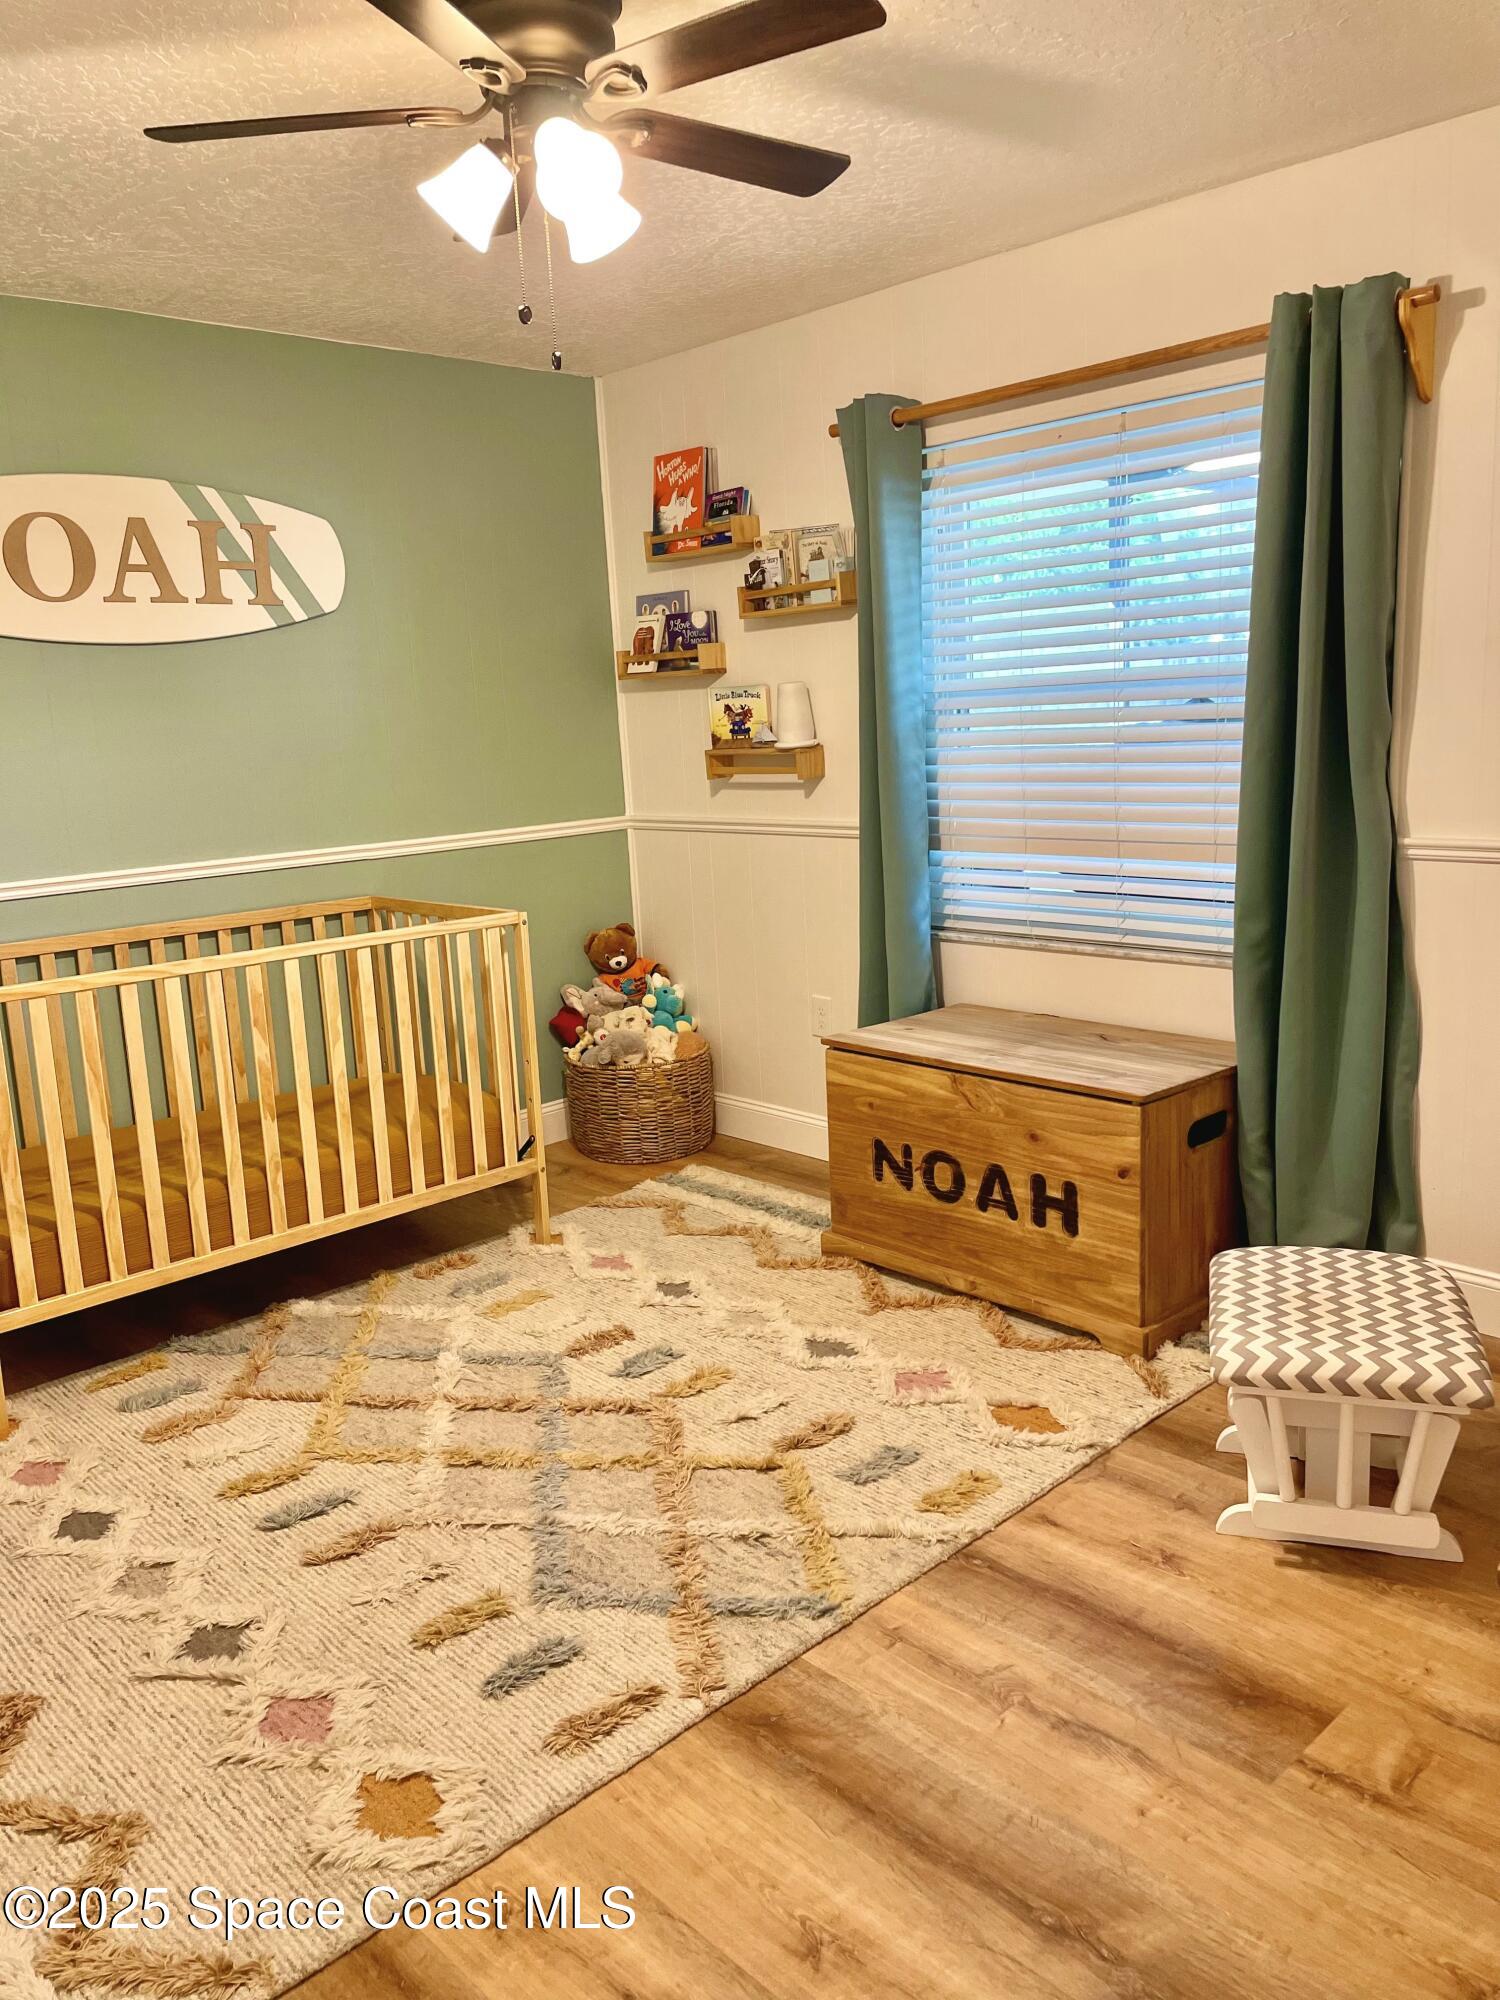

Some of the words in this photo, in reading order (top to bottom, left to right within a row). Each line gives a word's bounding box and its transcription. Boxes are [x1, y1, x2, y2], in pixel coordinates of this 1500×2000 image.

[673, 618, 691, 632] Love
[744, 690, 761, 699] Truck
[872, 1136, 1080, 1238] NOAH
